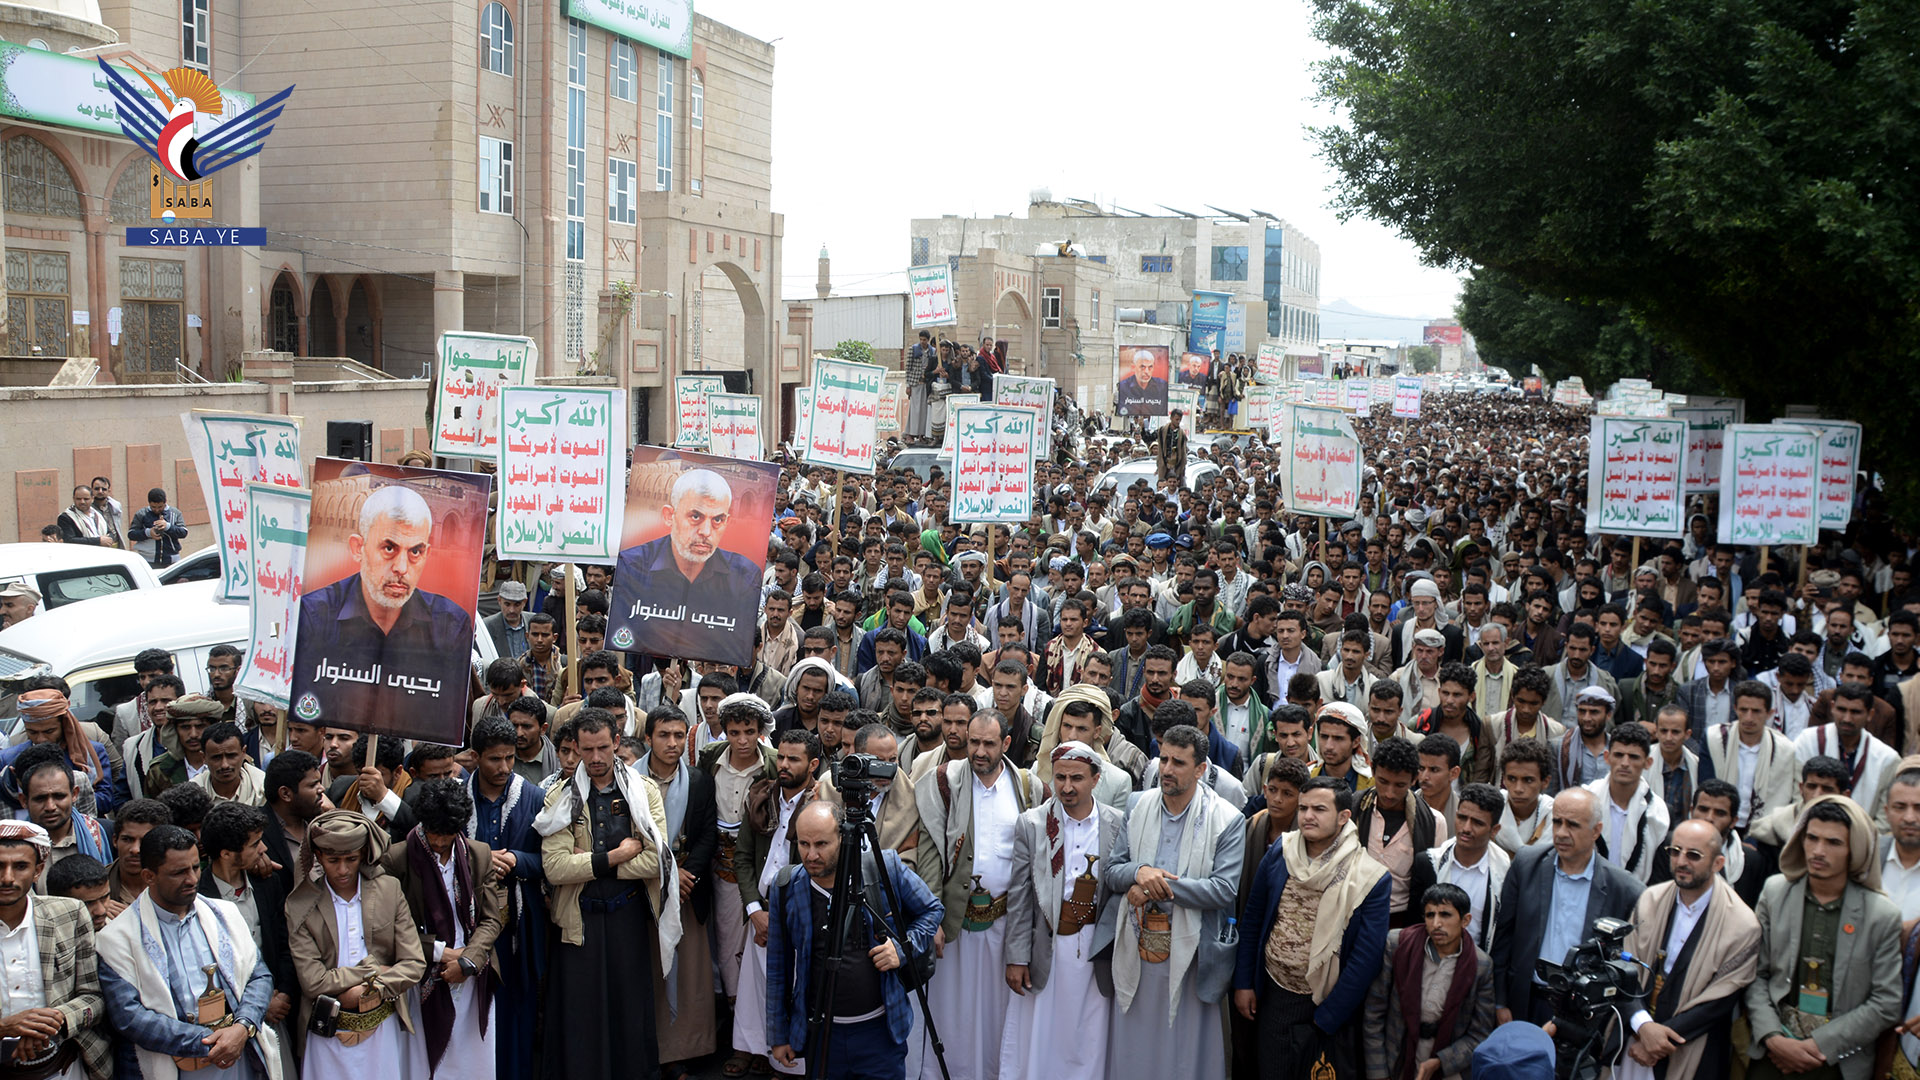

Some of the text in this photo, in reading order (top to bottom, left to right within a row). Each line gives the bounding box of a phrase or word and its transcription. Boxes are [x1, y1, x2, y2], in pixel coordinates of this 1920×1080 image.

[627, 5, 648, 20] الكريم
[448, 345, 522, 372] قاطعوا
[820, 368, 878, 394] قاطعوا
[1029, 383, 1048, 395] الله
[476, 404, 482, 420] و
[506, 394, 605, 432] الله أكبر
[712, 402, 756, 418] قاطعوا
[817, 396, 848, 414] الأمريكية
[848, 401, 876, 420] البضائع
[962, 412, 1003, 439] أكبر
[1004, 416, 1029, 434] الله
[216, 425, 267, 465] أكبر
[1608, 423, 1679, 449] الله أكبر
[1828, 432, 1854, 448] الله
[508, 432, 604, 460] الموت لأمريكا
[813, 436, 872, 460] الإسرائيلية
[961, 438, 996, 456] لأمريكا
[999, 442, 1028, 456] الموت
[1739, 436, 1813, 462] الله أكبر
[1647, 452, 1677, 464] الموت
[1822, 456, 1851, 467] الموت
[508, 462, 603, 488] الموت لإسرائيل
[960, 459, 1027, 476] الموت لإسرائيل
[1780, 466, 1812, 479] الموت
[1606, 470, 1676, 485] الموت لإسرائيل
[1822, 474, 1851, 485] الموت
[959, 480, 1026, 495] اللعنة على اليهود
[1605, 488, 1674, 503] اللعنة على اليهود
[1737, 483, 1812, 500] الموت لإسرائيل
[1826, 490, 1850, 502] اللعنة
[507, 494, 603, 516] اللعنة على اليهود
[1295, 486, 1355, 509] الإسرائيلية
[958, 497, 1026, 518] النصر للإسلام
[1604, 504, 1674, 527] النصر للإسلام
[1736, 504, 1811, 520] اللعنة على اليهود
[506, 519, 601, 551] النصر للإسلام
[1734, 522, 1810, 543] النصر للإسلام
[628, 599, 736, 632] يحيى السنوار
[313, 658, 441, 698] يحيى السنوار
